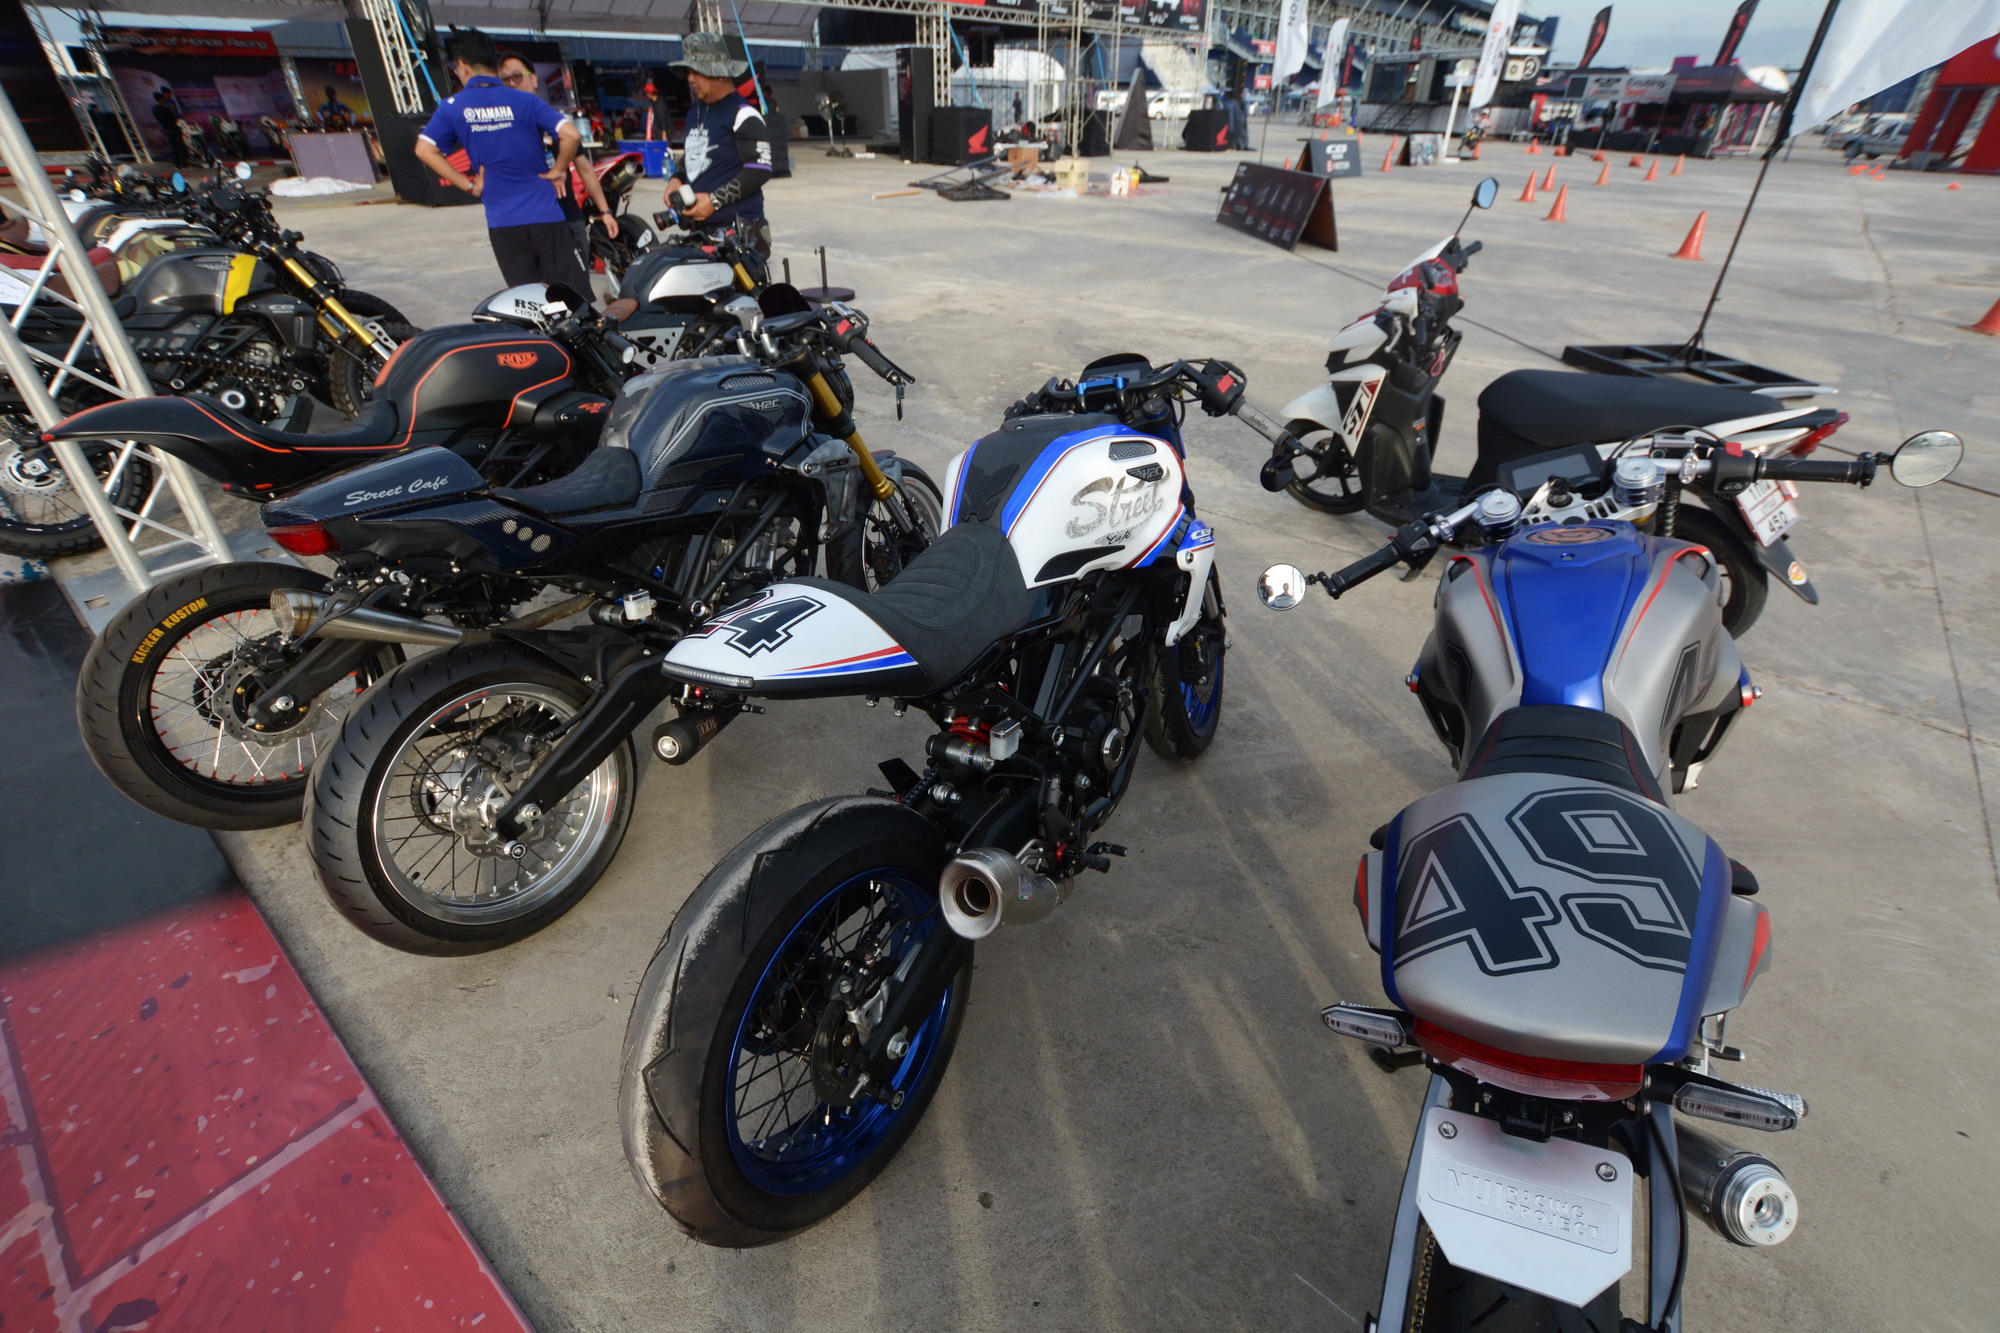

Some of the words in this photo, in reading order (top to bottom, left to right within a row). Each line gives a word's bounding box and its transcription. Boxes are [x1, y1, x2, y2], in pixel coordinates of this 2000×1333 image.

[107, 32, 160, 47] History
[163, 34, 179, 46] of
[182, 36, 224, 48] Honda
[474, 105, 514, 119] YAMAHA
[344, 485, 402, 506] Street
[1064, 466, 1171, 539] Street
[131, 627, 165, 664] KICKER
[161, 597, 209, 629] KUSTOM
[1393, 787, 1704, 977] 49
[1505, 1200, 1600, 1240] PROJECT
[1507, 1185, 1585, 1219] RACING
